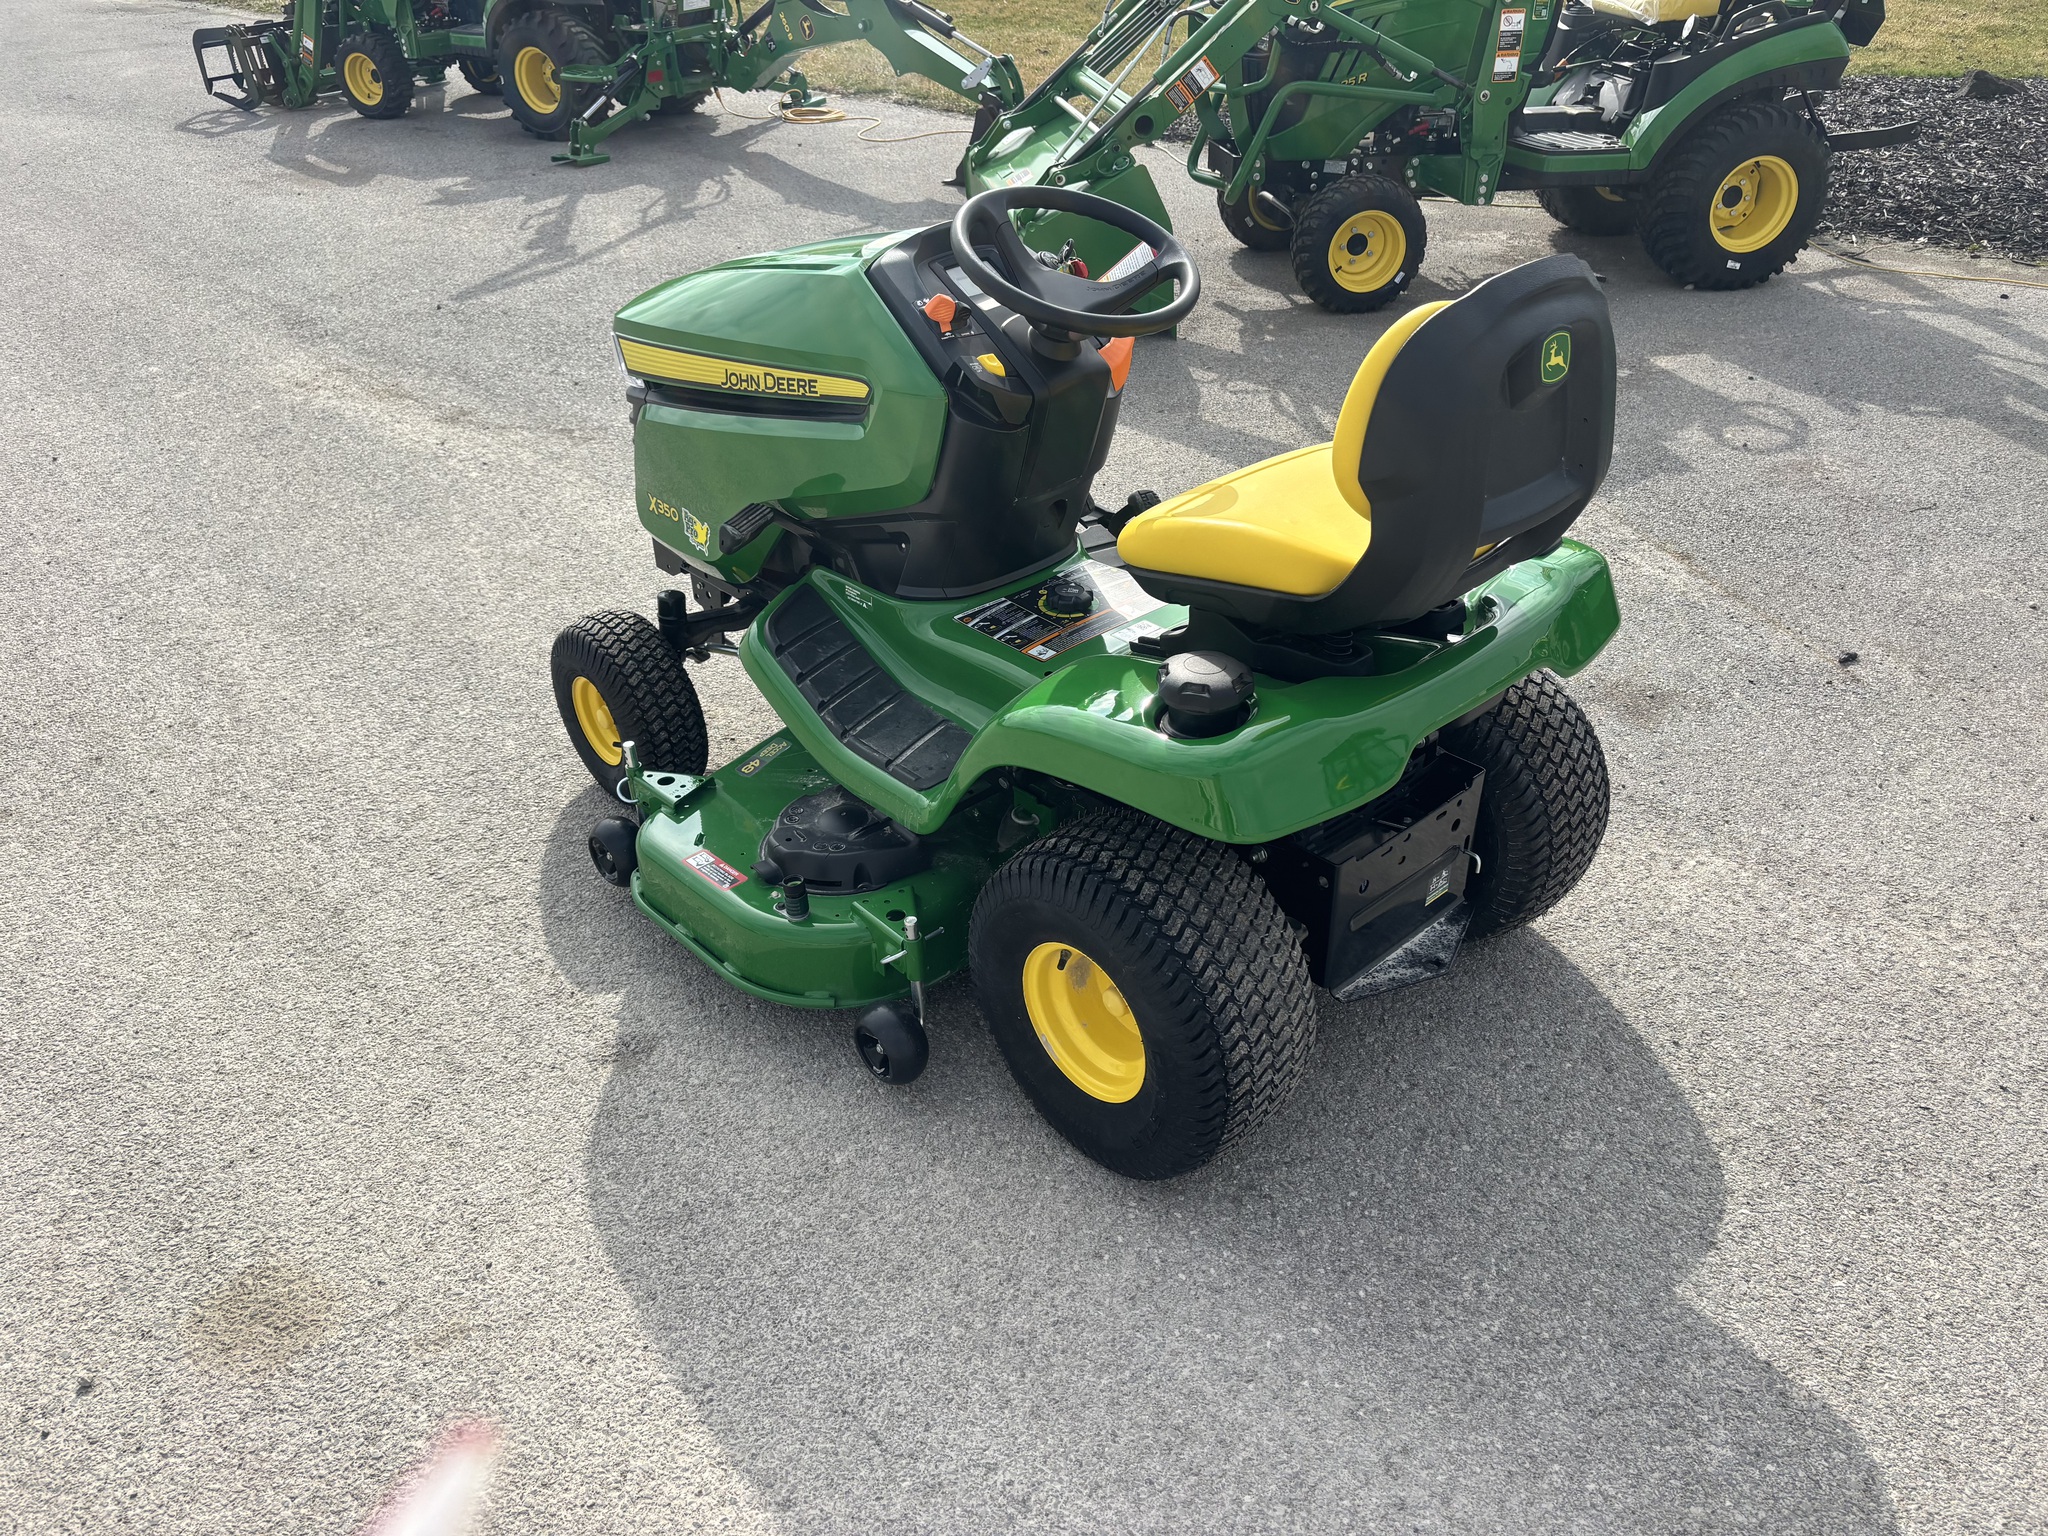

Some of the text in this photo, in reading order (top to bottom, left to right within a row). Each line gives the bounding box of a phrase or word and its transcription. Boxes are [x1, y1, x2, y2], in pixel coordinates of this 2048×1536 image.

[721, 368, 819, 396] JOHN DEERE
[647, 492, 679, 522] X350
[760, 743, 778, 757] DEEP
[741, 758, 760, 774] 48
